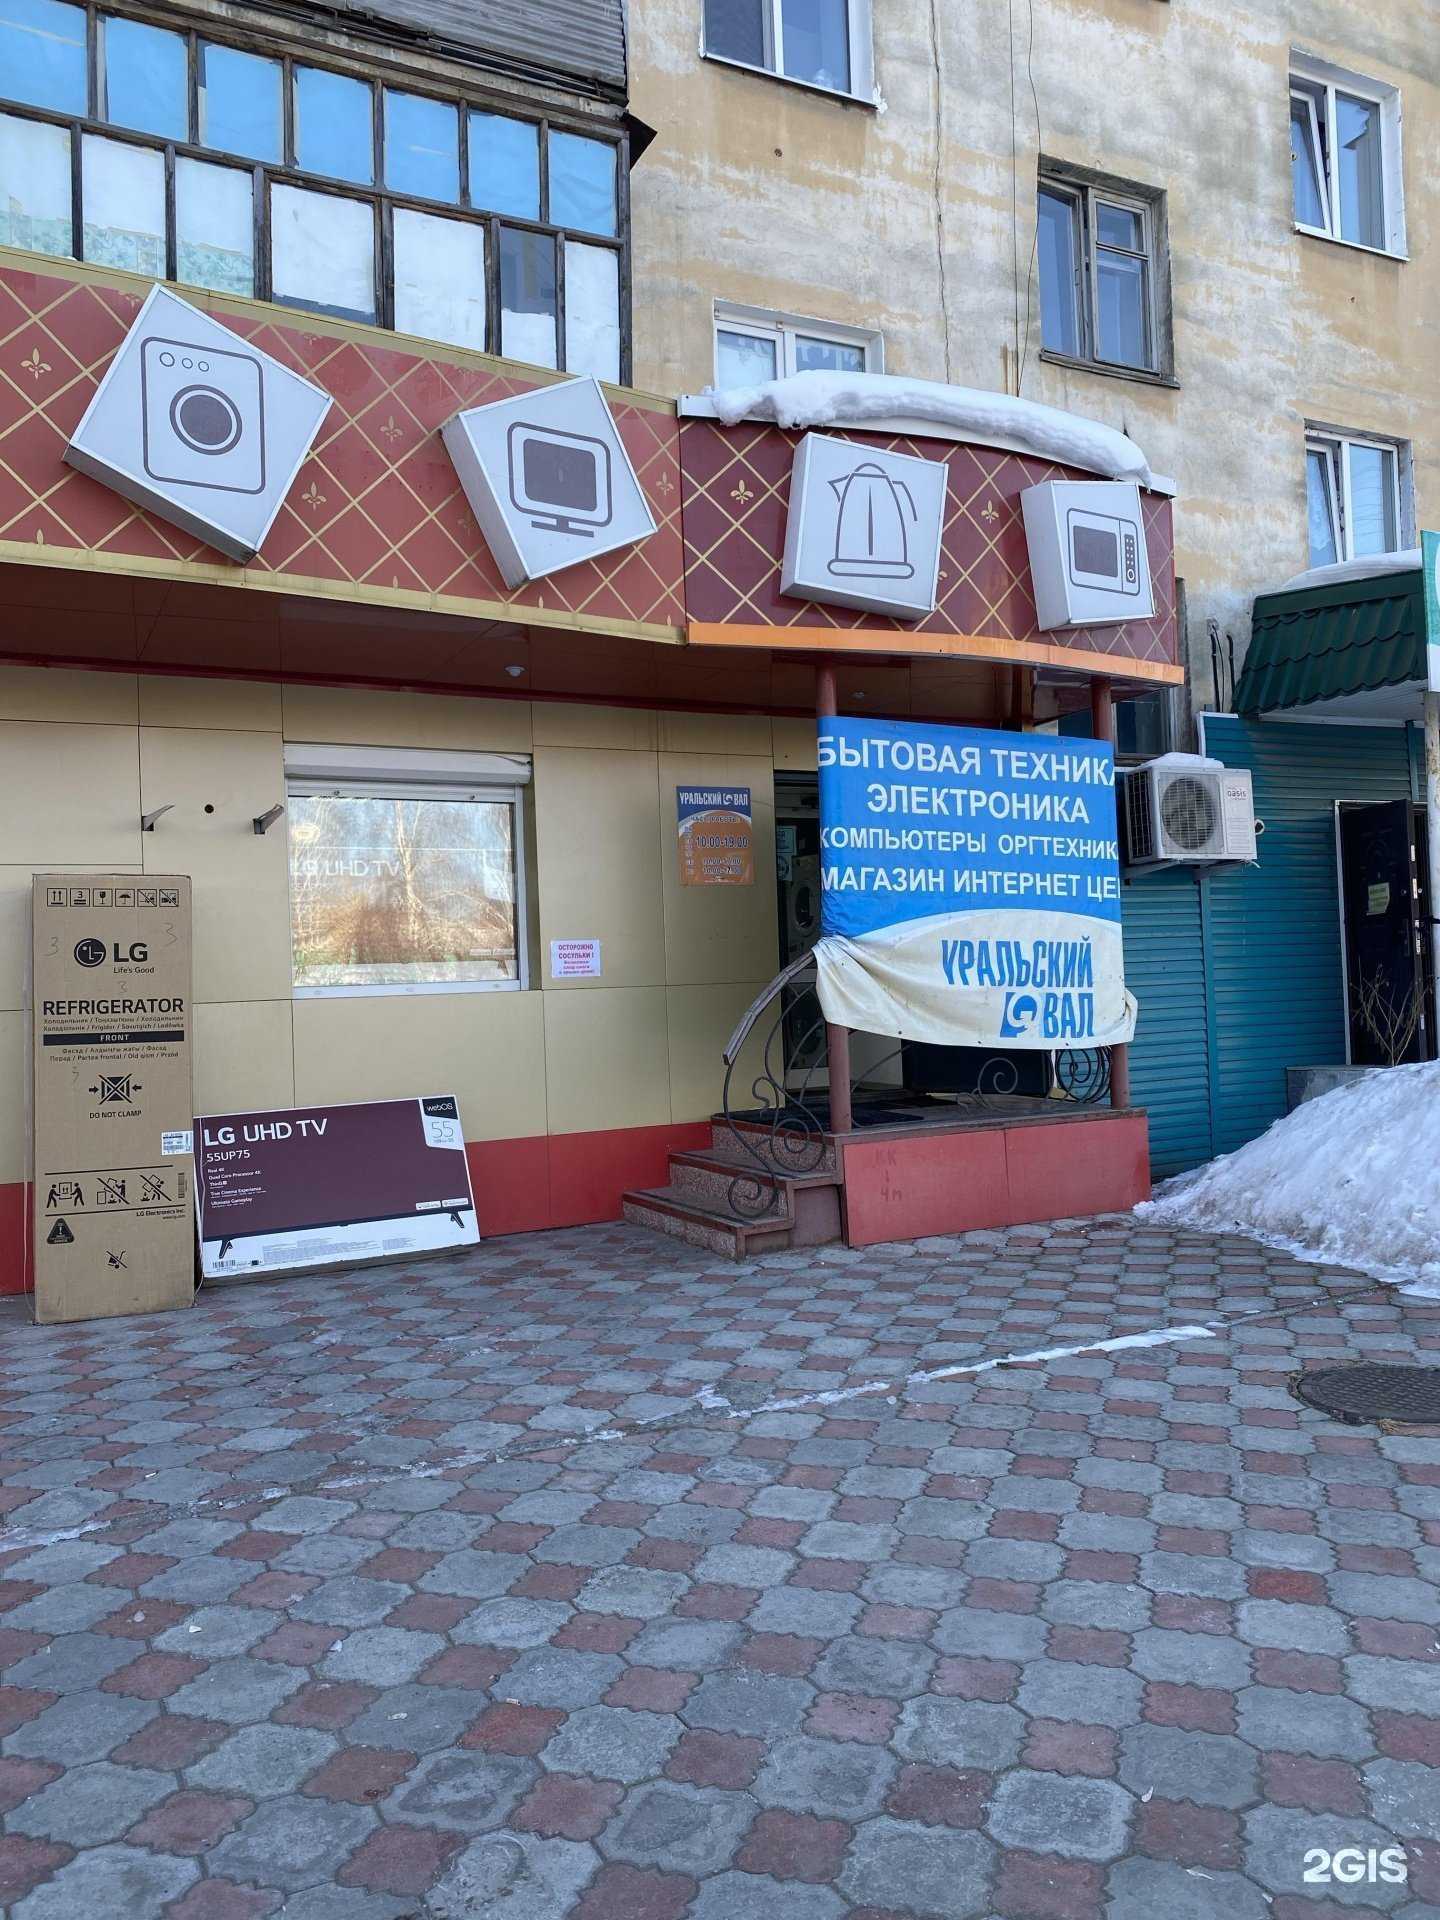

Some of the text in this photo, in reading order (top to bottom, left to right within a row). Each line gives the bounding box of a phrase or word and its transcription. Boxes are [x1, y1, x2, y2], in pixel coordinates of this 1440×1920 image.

[817, 736, 982, 776] БЫТОВАЯ
[680, 792, 748, 805] УРАЛЬСКИЙ ВАЛ
[867, 784, 1090, 824] ЭЛЕКТРОНИКА
[820, 827, 986, 854] КОМПЬЮТЕРЫ
[999, 834, 1119, 860] ОРГТЕХНИК
[326, 859, 369, 876] UHD
[372, 860, 400, 877] TV
[821, 867, 1120, 902] МАГАЗИН ИНТЕРНЕТ ЦЕ
[113, 942, 148, 963] LG
[941, 935, 1094, 988] УРАЛЬСКИЙ
[113, 966, 155, 974] Life's Good
[43, 998, 184, 1015] REFRIGERATOR
[1043, 992, 1095, 1038] ВАЛ
[100, 1034, 129, 1042] FRONT
[117, 1110, 142, 1118] CLAMP
[426, 1102, 454, 1112] webOS
[204, 1126, 235, 1147] LG
[243, 1121, 293, 1143] UHD
[296, 1118, 328, 1137] TV
[431, 1120, 454, 1139] 55
[206, 1149, 251, 1162] 55UP75
